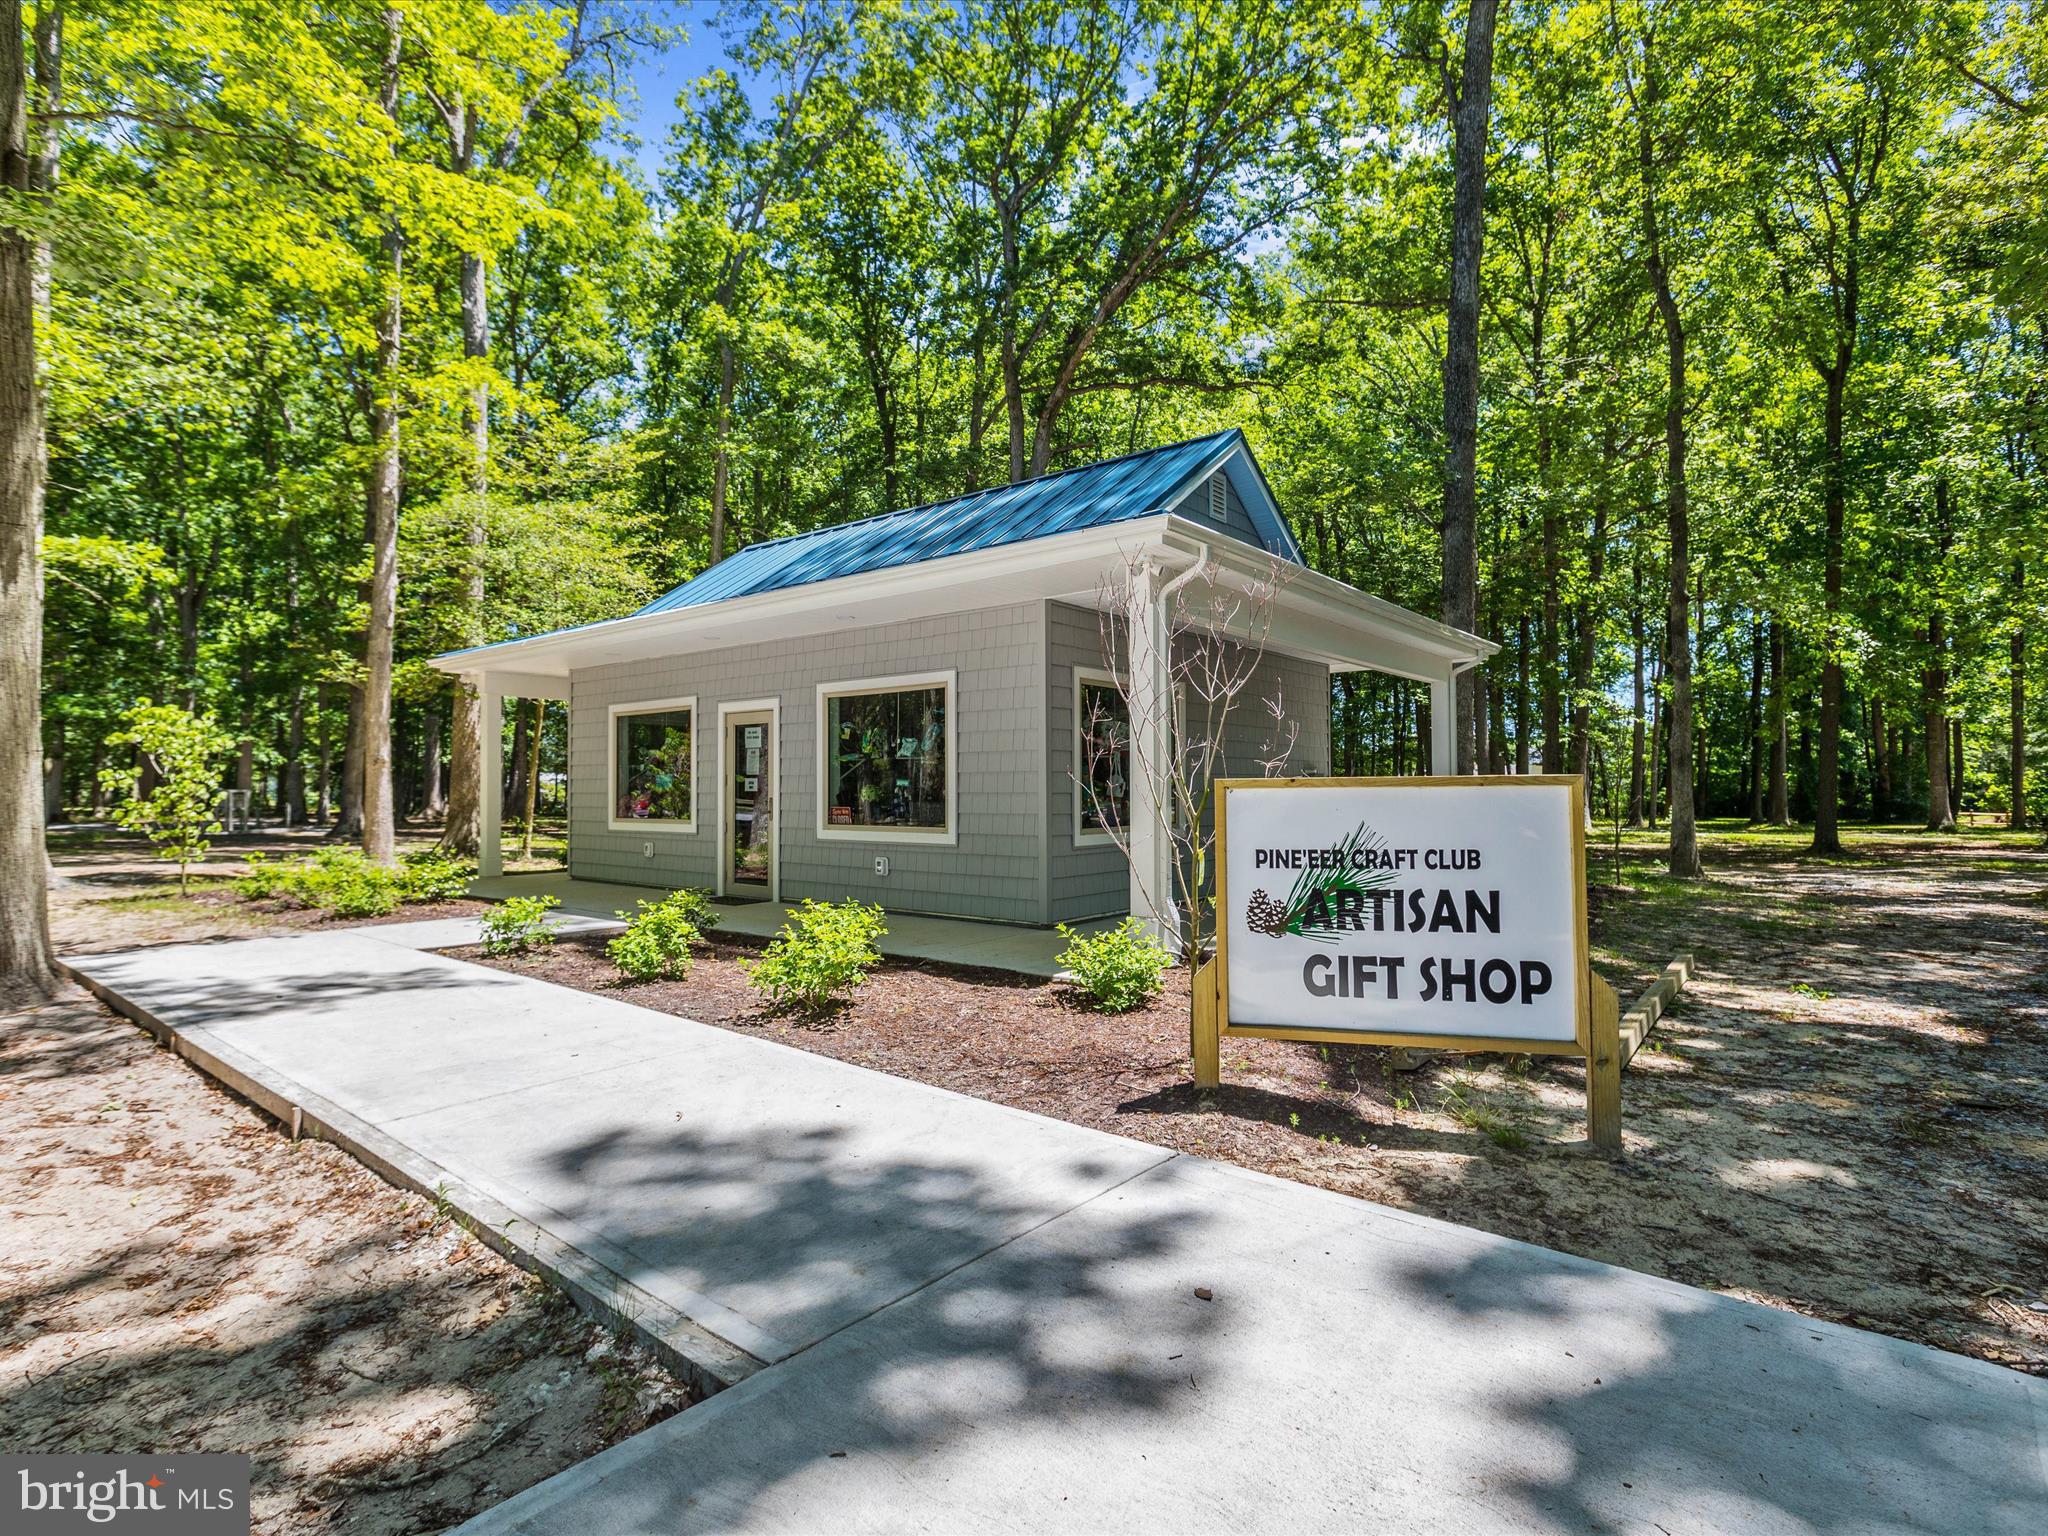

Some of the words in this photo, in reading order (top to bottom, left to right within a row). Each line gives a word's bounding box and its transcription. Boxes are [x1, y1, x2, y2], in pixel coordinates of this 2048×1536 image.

[1255, 849, 1346, 869] PINE'EER
[1351, 849, 1419, 870] CRAFT
[1424, 849, 1481, 870] CLUB
[1301, 888, 1501, 934] ARTISAN
[1303, 953, 1405, 1000] GIFT
[1419, 956, 1553, 1005] SHOP
